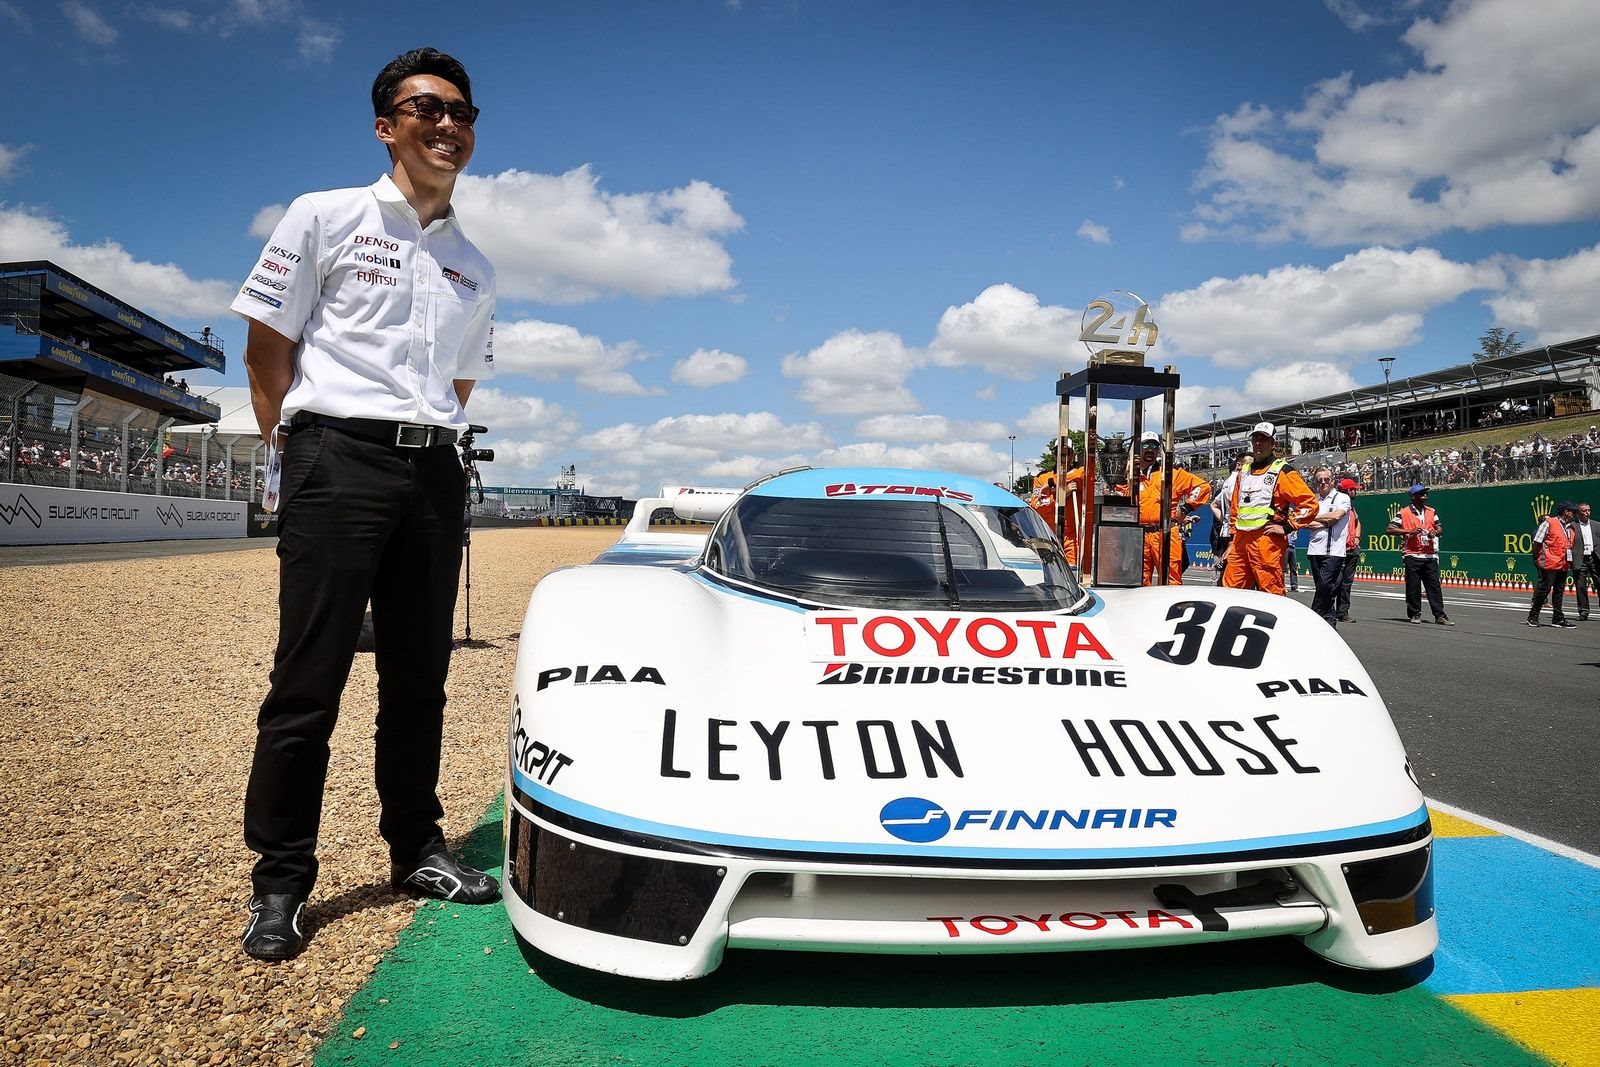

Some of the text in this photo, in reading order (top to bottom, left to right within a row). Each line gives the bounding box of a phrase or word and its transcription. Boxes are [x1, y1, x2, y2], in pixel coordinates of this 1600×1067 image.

[354, 235, 399, 252] DENSO
[268, 245, 302, 264] AISIN
[354, 252, 388, 267] Mobil
[261, 258, 291, 277] ZENT
[251, 273, 287, 292] RAYS
[357, 268, 397, 287] FUJITSU
[57, 282, 88, 302] GOODYEAR
[117, 311, 142, 329] GOODYEAR
[51, 346, 82, 364] GOODYEAR
[111, 369, 136, 385] GOODYEAR
[503, 487, 544, 495] Bienvenue
[48, 505, 140, 520] SUZUKA CIRCUIT
[186, 511, 241, 522] SUZUKA CIRCUIT
[1368, 534, 1404, 552] ROL
[1354, 564, 1373, 574] OLEX
[1440, 569, 1469, 579] ROLEX
[1494, 572, 1528, 582] ROLEX
[815, 615, 1114, 661] TOYOTA
[1146, 600, 1278, 670] 36
[536, 665, 667, 692] PIAA
[816, 662, 1128, 688] BRIDGESTONE
[1256, 677, 1369, 699] PIAA
[512, 693, 575, 786] COCKPIT
[660, 708, 1321, 781] LEYTON HOUSE
[953, 808, 1178, 831] FINNAIR
[926, 909, 1194, 938] TOYOTA
